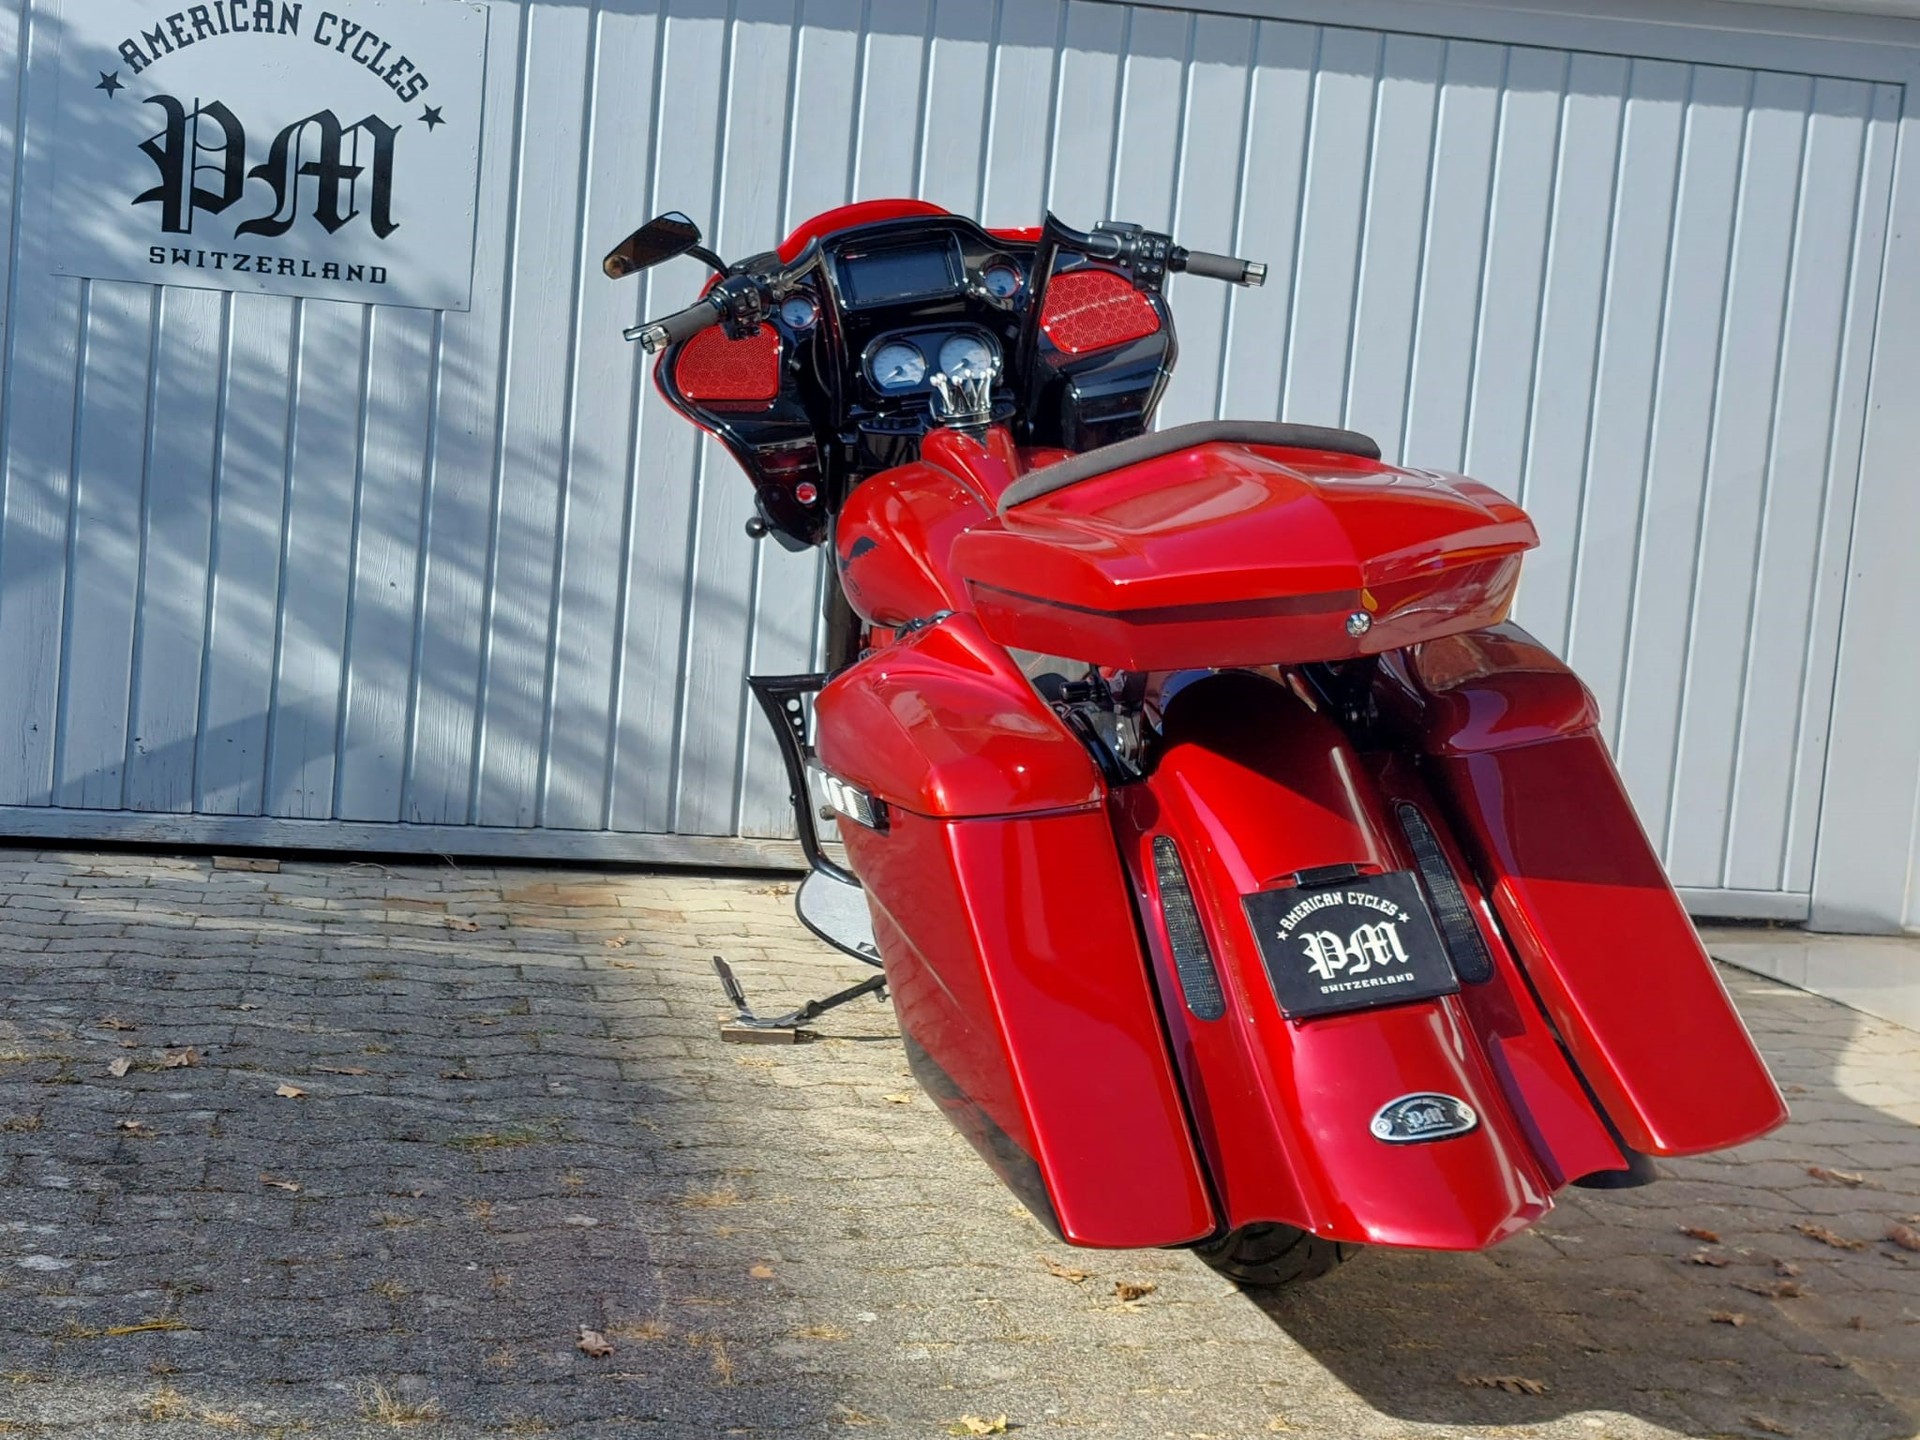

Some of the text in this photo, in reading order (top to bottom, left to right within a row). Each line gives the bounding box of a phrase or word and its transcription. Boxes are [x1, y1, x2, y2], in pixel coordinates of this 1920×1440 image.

[118, 0, 429, 103] AMERICAN CYCLES
[149, 246, 387, 284] SWITZERLAND
[1279, 891, 1399, 930] AMERICAN CYCLES
[1320, 972, 1415, 994] SWITZERLAND
